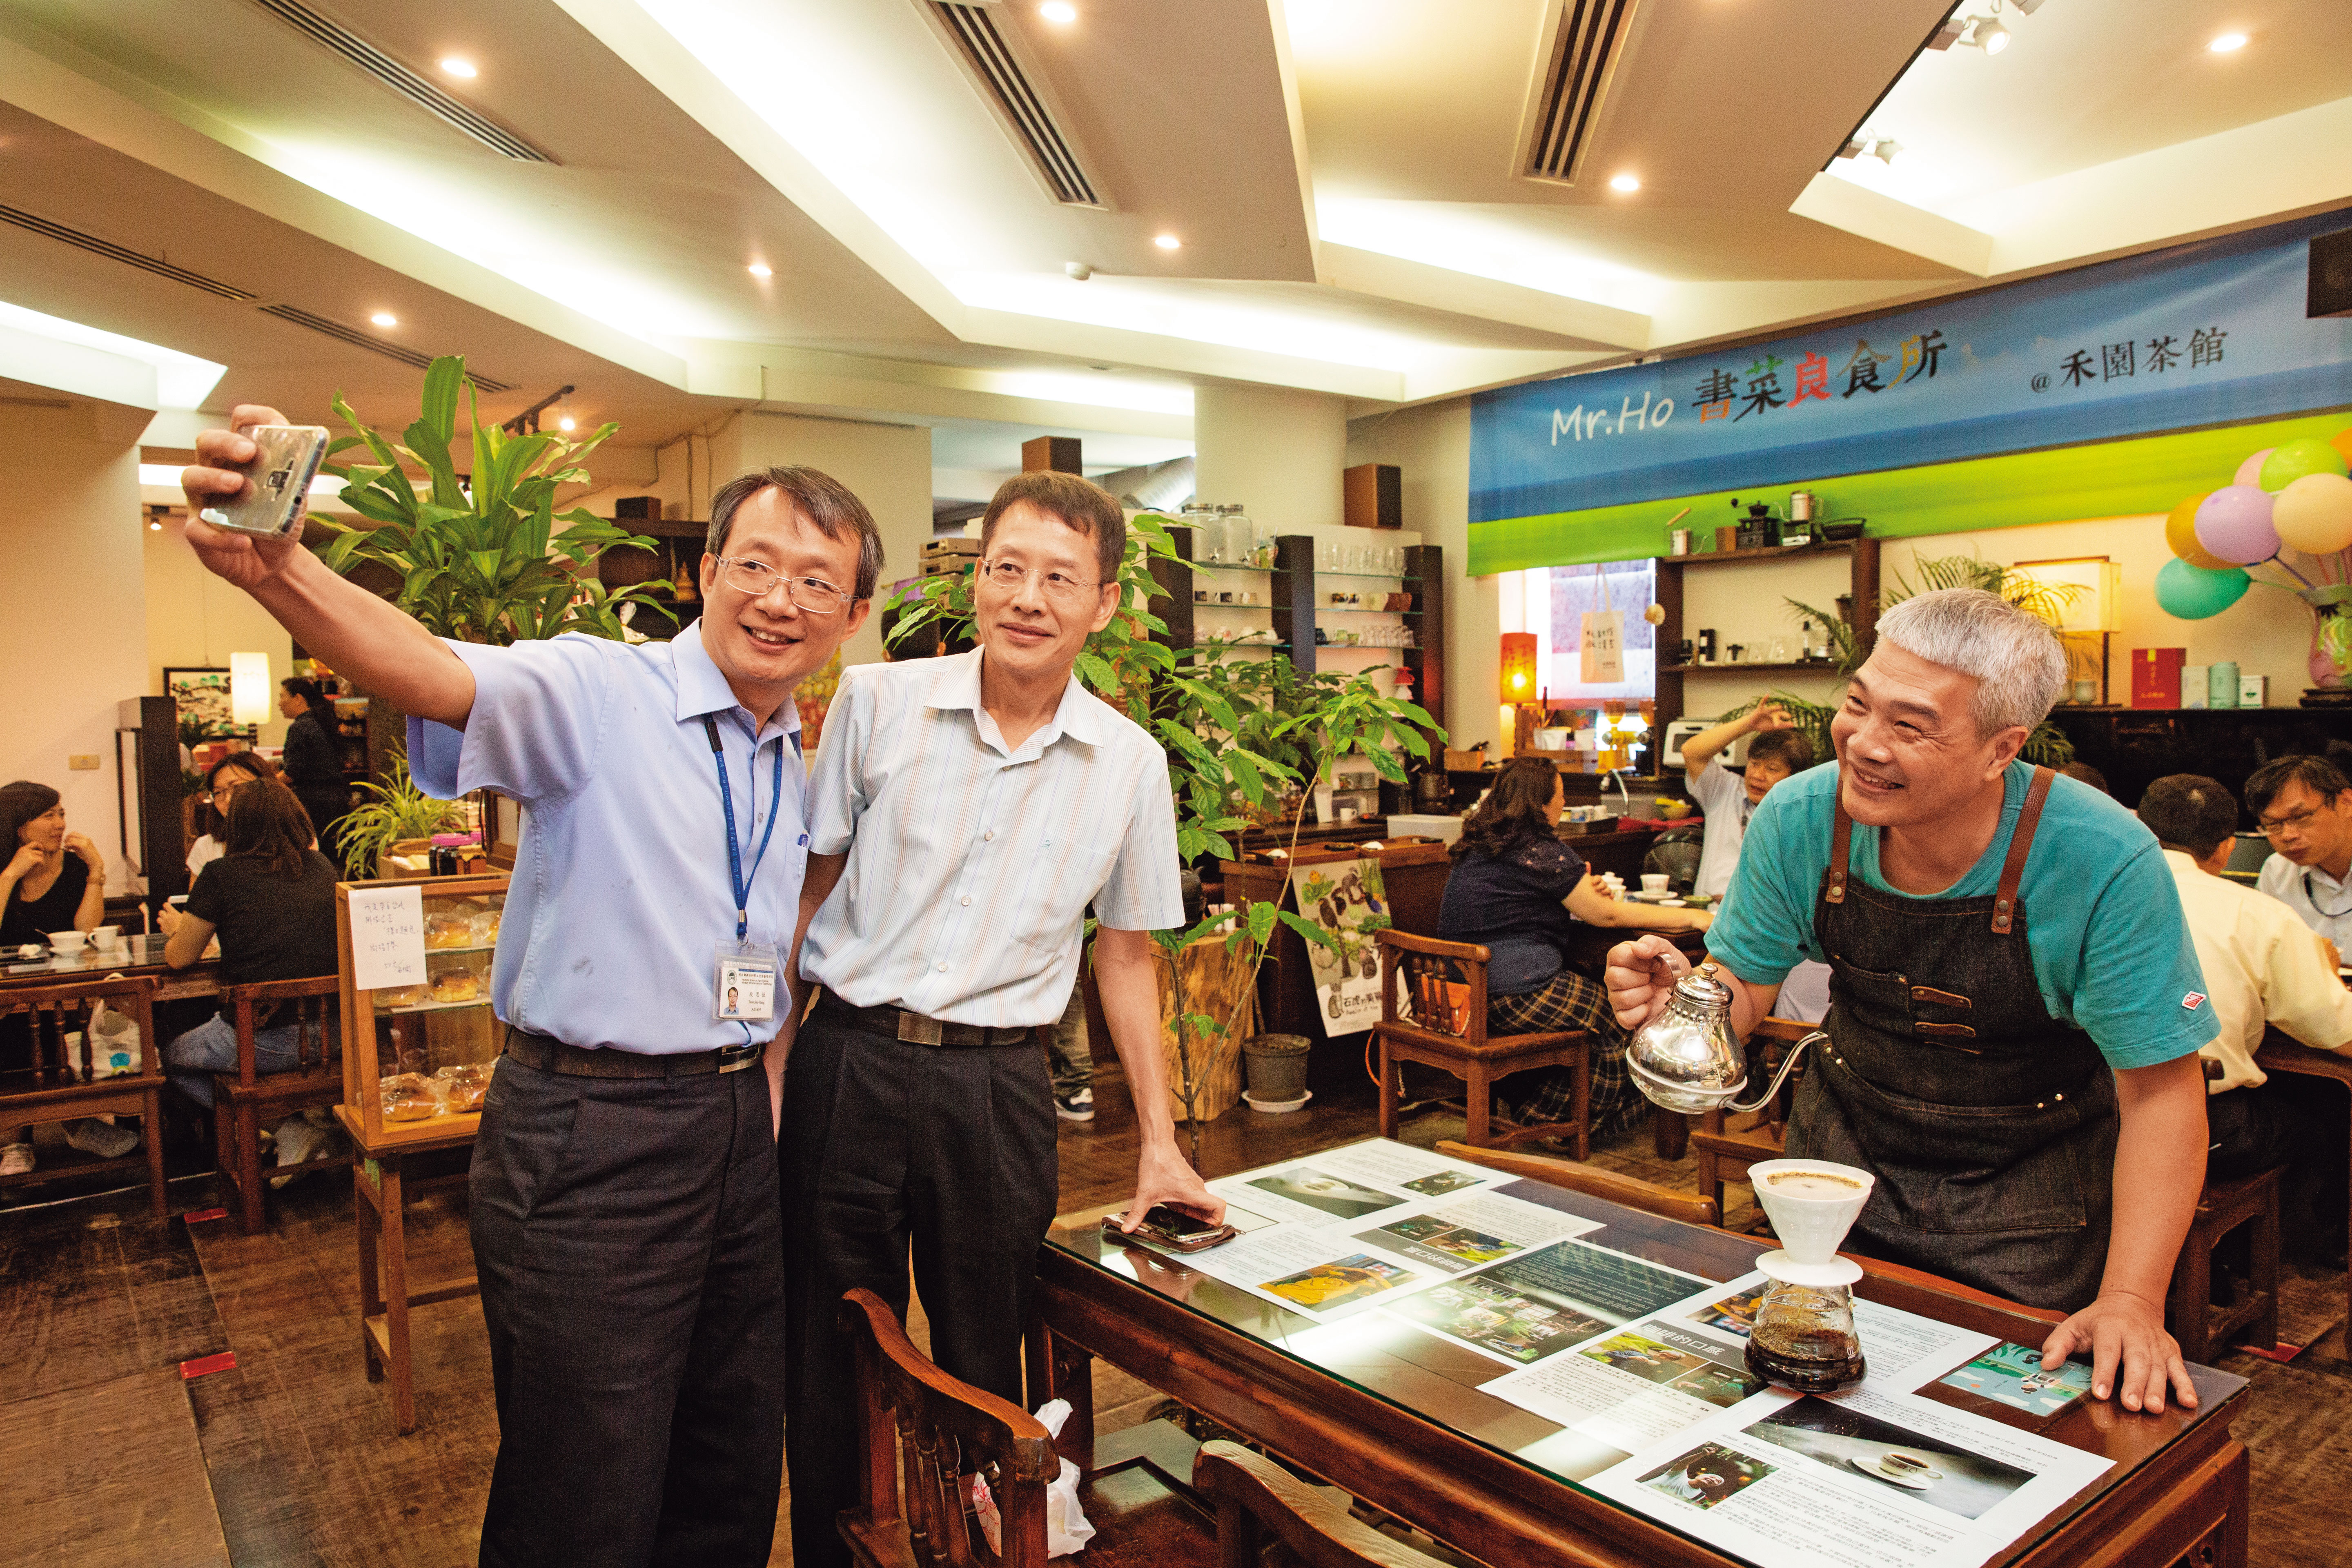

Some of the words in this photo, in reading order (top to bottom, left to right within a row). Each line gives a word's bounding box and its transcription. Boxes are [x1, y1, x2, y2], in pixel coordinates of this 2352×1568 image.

[1552, 391, 1675, 446] Mr.Ho
[1692, 329, 1948, 424] 書菜良食所
[2060, 326, 2228, 387] 禾園茶館
[1642, 1324, 1725, 1355] 咖啡的口感
